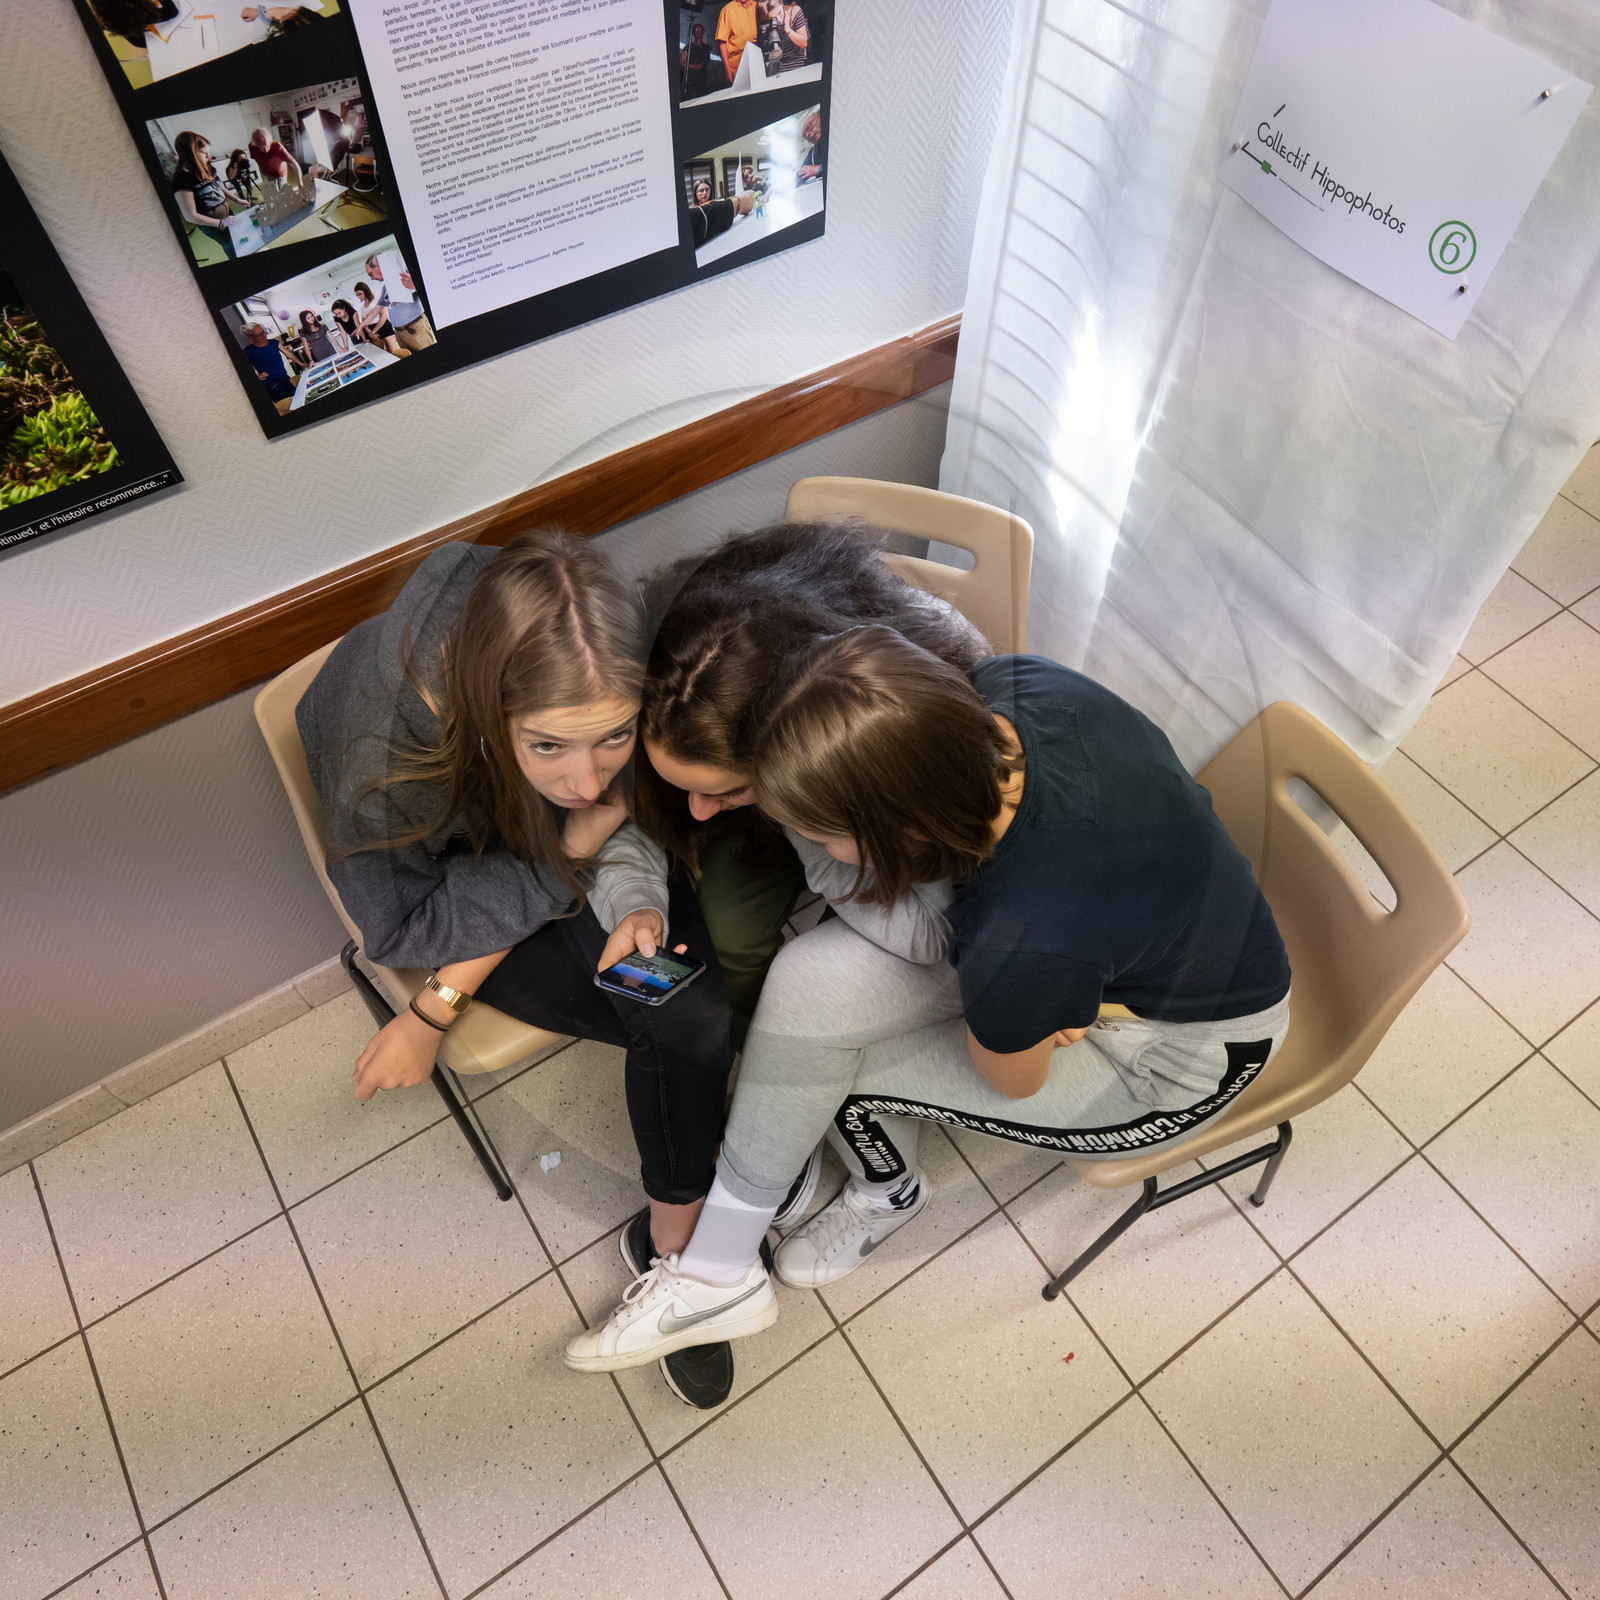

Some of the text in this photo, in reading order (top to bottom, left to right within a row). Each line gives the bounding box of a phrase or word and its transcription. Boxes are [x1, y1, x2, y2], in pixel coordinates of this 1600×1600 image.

[400, 82, 418, 91] Nous
[418, 76, 437, 86] avons
[437, 71, 455, 80] repris
[466, 63, 485, 72] bases
[494, 56, 509, 64] cette
[510, 50, 531, 60] histoire
[550, 36, 574, 49] tournant
[574, 33, 588, 43] pour
[588, 29, 606, 38] mettre
[615, 21, 632, 30] cause
[424, 56, 439, 65] l'âne
[439, 50, 458, 62] perdit
[466, 43, 486, 53] culotte
[493, 34, 518, 46] redevint
[407, 108, 422, 117] Pour
[449, 96, 465, 104] nous
[466, 90, 485, 100] avons
[514, 77, 528, 86] l'âne
[530, 72, 549, 81] culotte
[551, 68, 560, 76] par
[612, 49, 626, 58] c'est
[409, 115, 431, 125] insecte
[432, 110, 442, 120] qui
[443, 107, 454, 115] est
[454, 102, 473, 112] oublié
[474, 99, 484, 108] par
[493, 90, 514, 102] plupart
[526, 82, 541, 93] gens
[588, 63, 608, 73] comme
[609, 55, 636, 67] beaucoup
[413, 87, 431, 97] sujets
[431, 80, 453, 92] actuels
[468, 70, 490, 80] France
[490, 64, 512, 75] comme
[444, 115, 458, 124] sont
[471, 105, 496, 116] espèces
[497, 96, 527, 108] menacées
[535, 89, 545, 98] qui
[546, 78, 582, 94] disparaissent
[583, 76, 594, 84] peu
[623, 64, 636, 72] sans
[415, 141, 432, 151] Donc
[432, 137, 447, 146] nous
[447, 131, 465, 141] avons
[465, 125, 482, 136] choisi
[482, 120, 504, 130] l'abeille
[545, 103, 560, 112] base
[417, 148, 441, 159] lunettes
[442, 142, 455, 151] sont
[464, 128, 505, 144] caractéristique
[506, 121, 527, 132] comme
[535, 113, 554, 123] culotte
[587, 97, 608, 108] paradis
[608, 90, 630, 101] terrestre
[420, 155, 441, 167] devenir
[450, 147, 471, 157] monde
[471, 142, 485, 151] sans
[485, 135, 509, 148] pollution
[509, 131, 523, 140] pour
[523, 124, 540, 135] lequel
[540, 119, 561, 129] l'abeille
[569, 112, 584, 121] créer
[596, 104, 612, 113] armée
[613, 96, 639, 108] d'animaux
[422, 166, 435, 176] pour
[456, 152, 482, 164] hommes
[425, 181, 442, 190] Notre
[442, 175, 460, 186] projet
[460, 168, 485, 179] dénonce
[485, 163, 500, 171] donc
[510, 153, 534, 164] hommes
[534, 149, 544, 157] qui
[544, 140, 571, 153] détruisent
[583, 131, 603, 142] planète
[611, 124, 620, 133] qui
[1311, 160, 1407, 234] Hippophotos
[1439, 230, 1468, 266] 6
[39, 521, 52, 531] et
[52, 504, 94, 526] l'histoire
[95, 474, 168, 509] recommence..."
[1195, 1062, 1262, 1114] Nothing
[962, 1117, 986, 1130] in
[986, 1122, 1074, 1150] Nothing
[1067, 1117, 1180, 1151] COMMON
[1172, 1112, 1196, 1125] in
